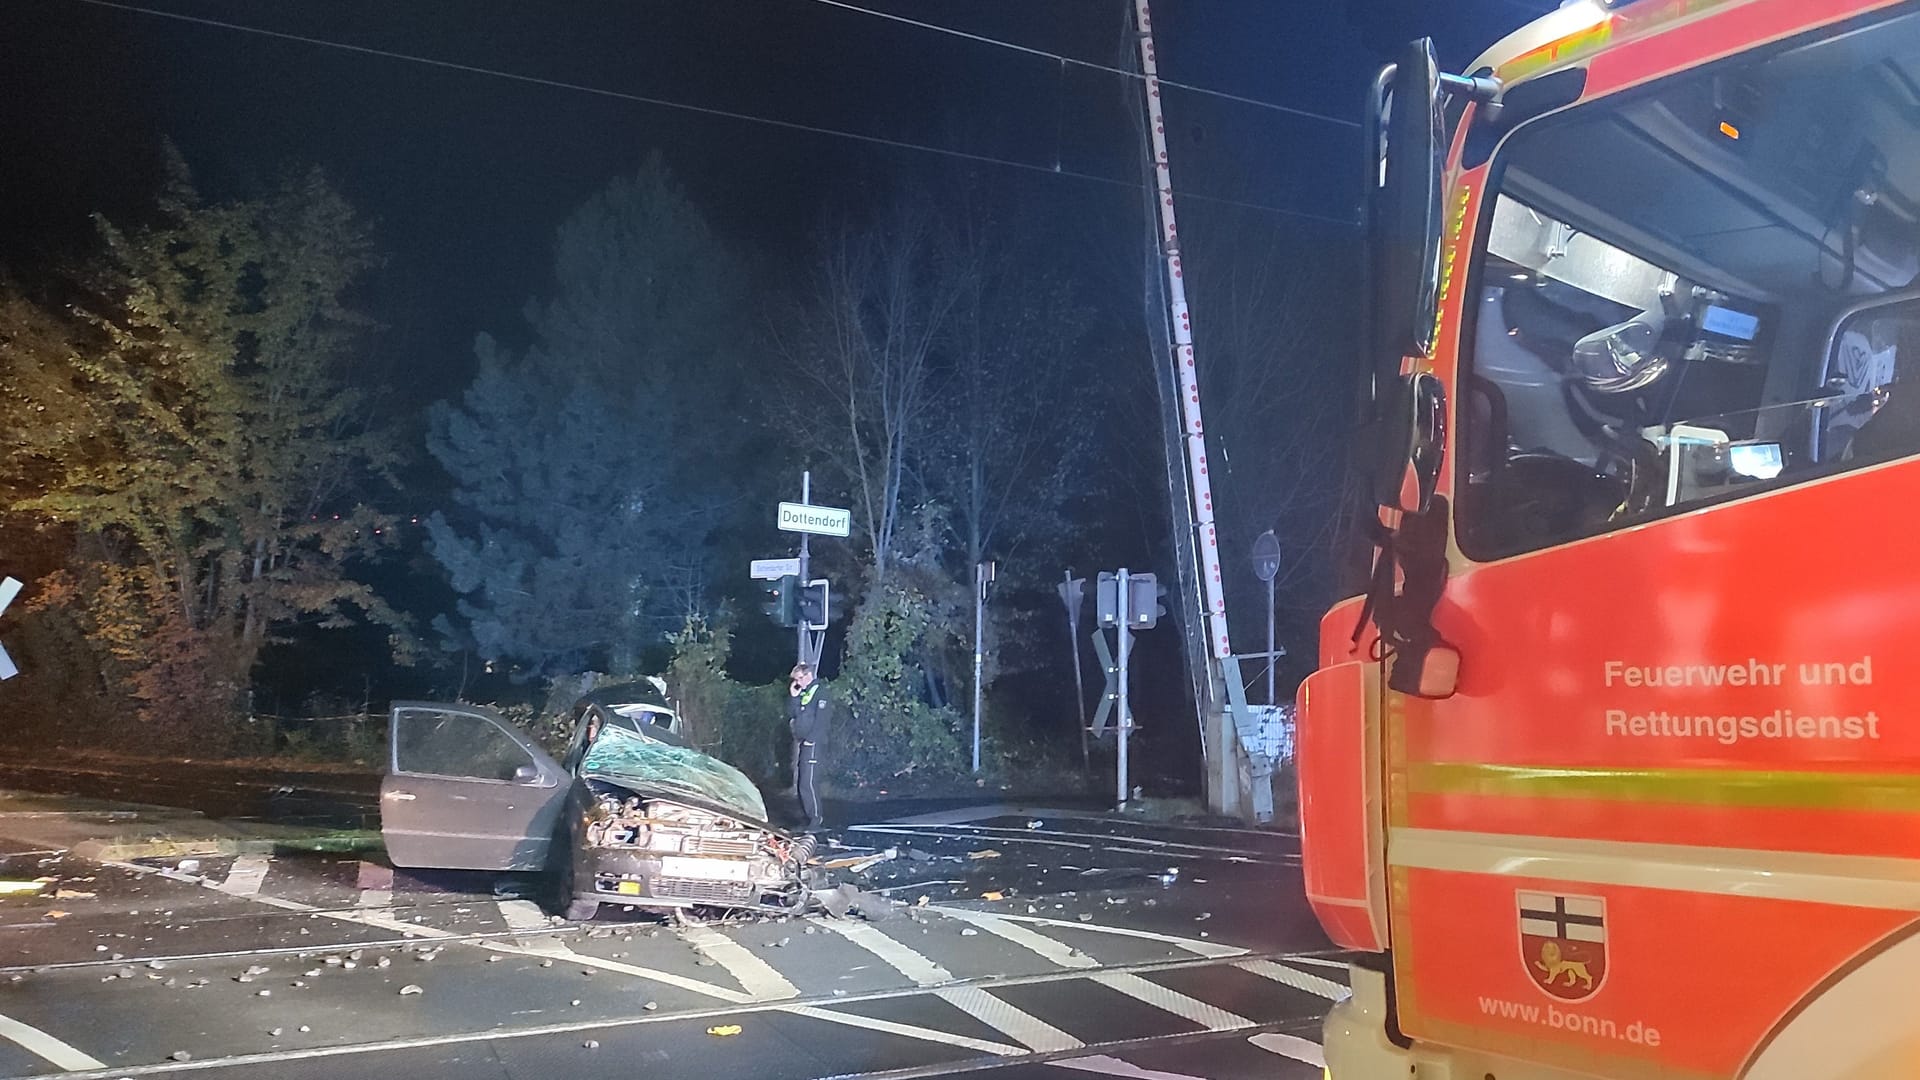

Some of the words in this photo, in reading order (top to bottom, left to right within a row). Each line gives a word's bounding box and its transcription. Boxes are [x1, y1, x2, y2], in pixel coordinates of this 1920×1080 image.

[783, 510, 846, 528] Dottendorf
[1604, 658, 1786, 687] Feuerwehr
[1799, 656, 1872, 685] und
[1605, 709, 1880, 744] Rettungsdienst
[1478, 995, 1662, 1047] www.bonn.de
